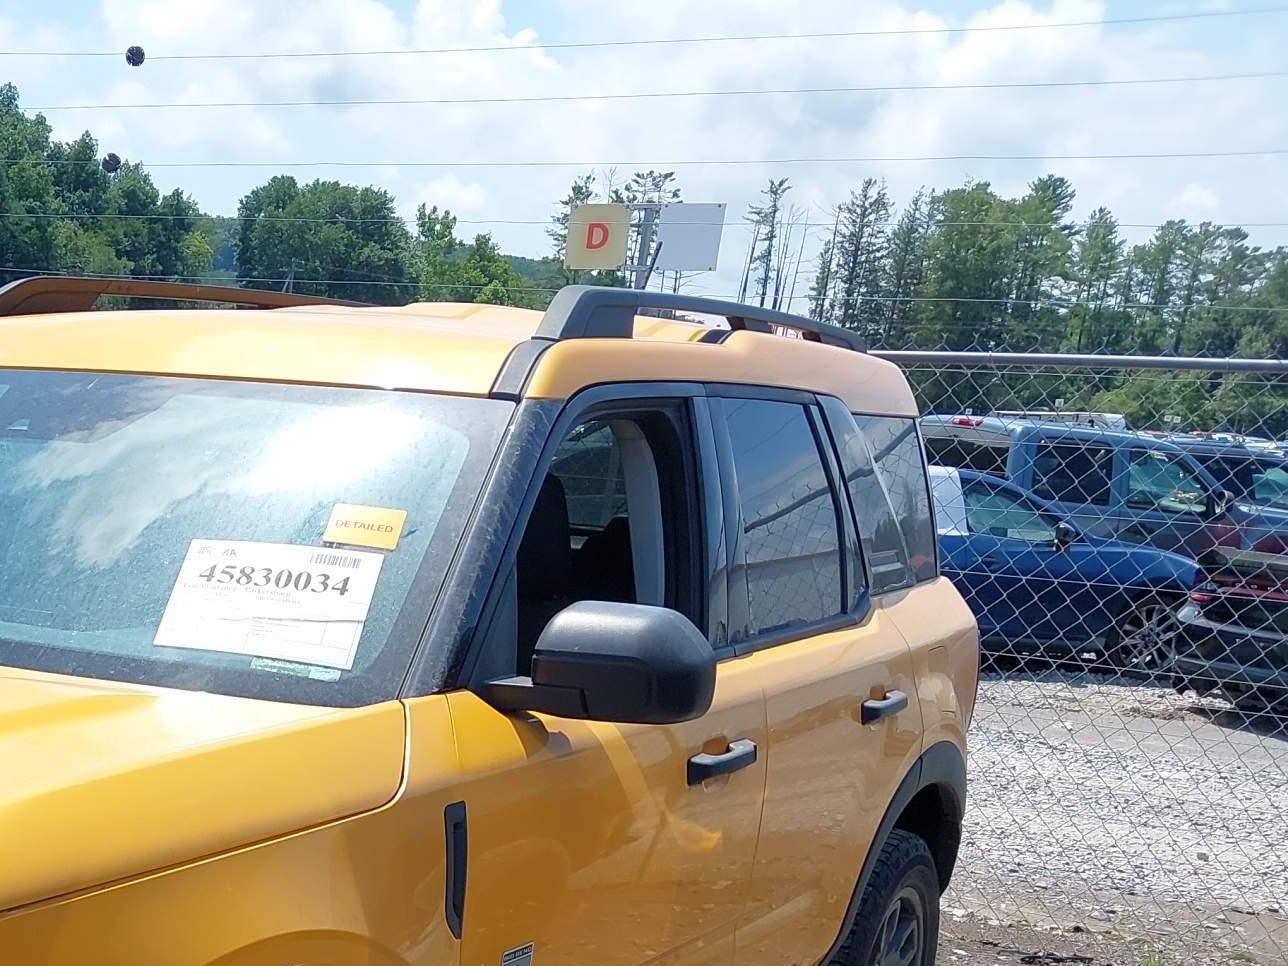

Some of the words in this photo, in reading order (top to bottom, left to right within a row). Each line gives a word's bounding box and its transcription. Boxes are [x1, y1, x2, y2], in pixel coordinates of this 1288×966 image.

[585, 222, 610, 250] D
[335, 519, 394, 533] DETAILED
[198, 563, 351, 597] 45830034
